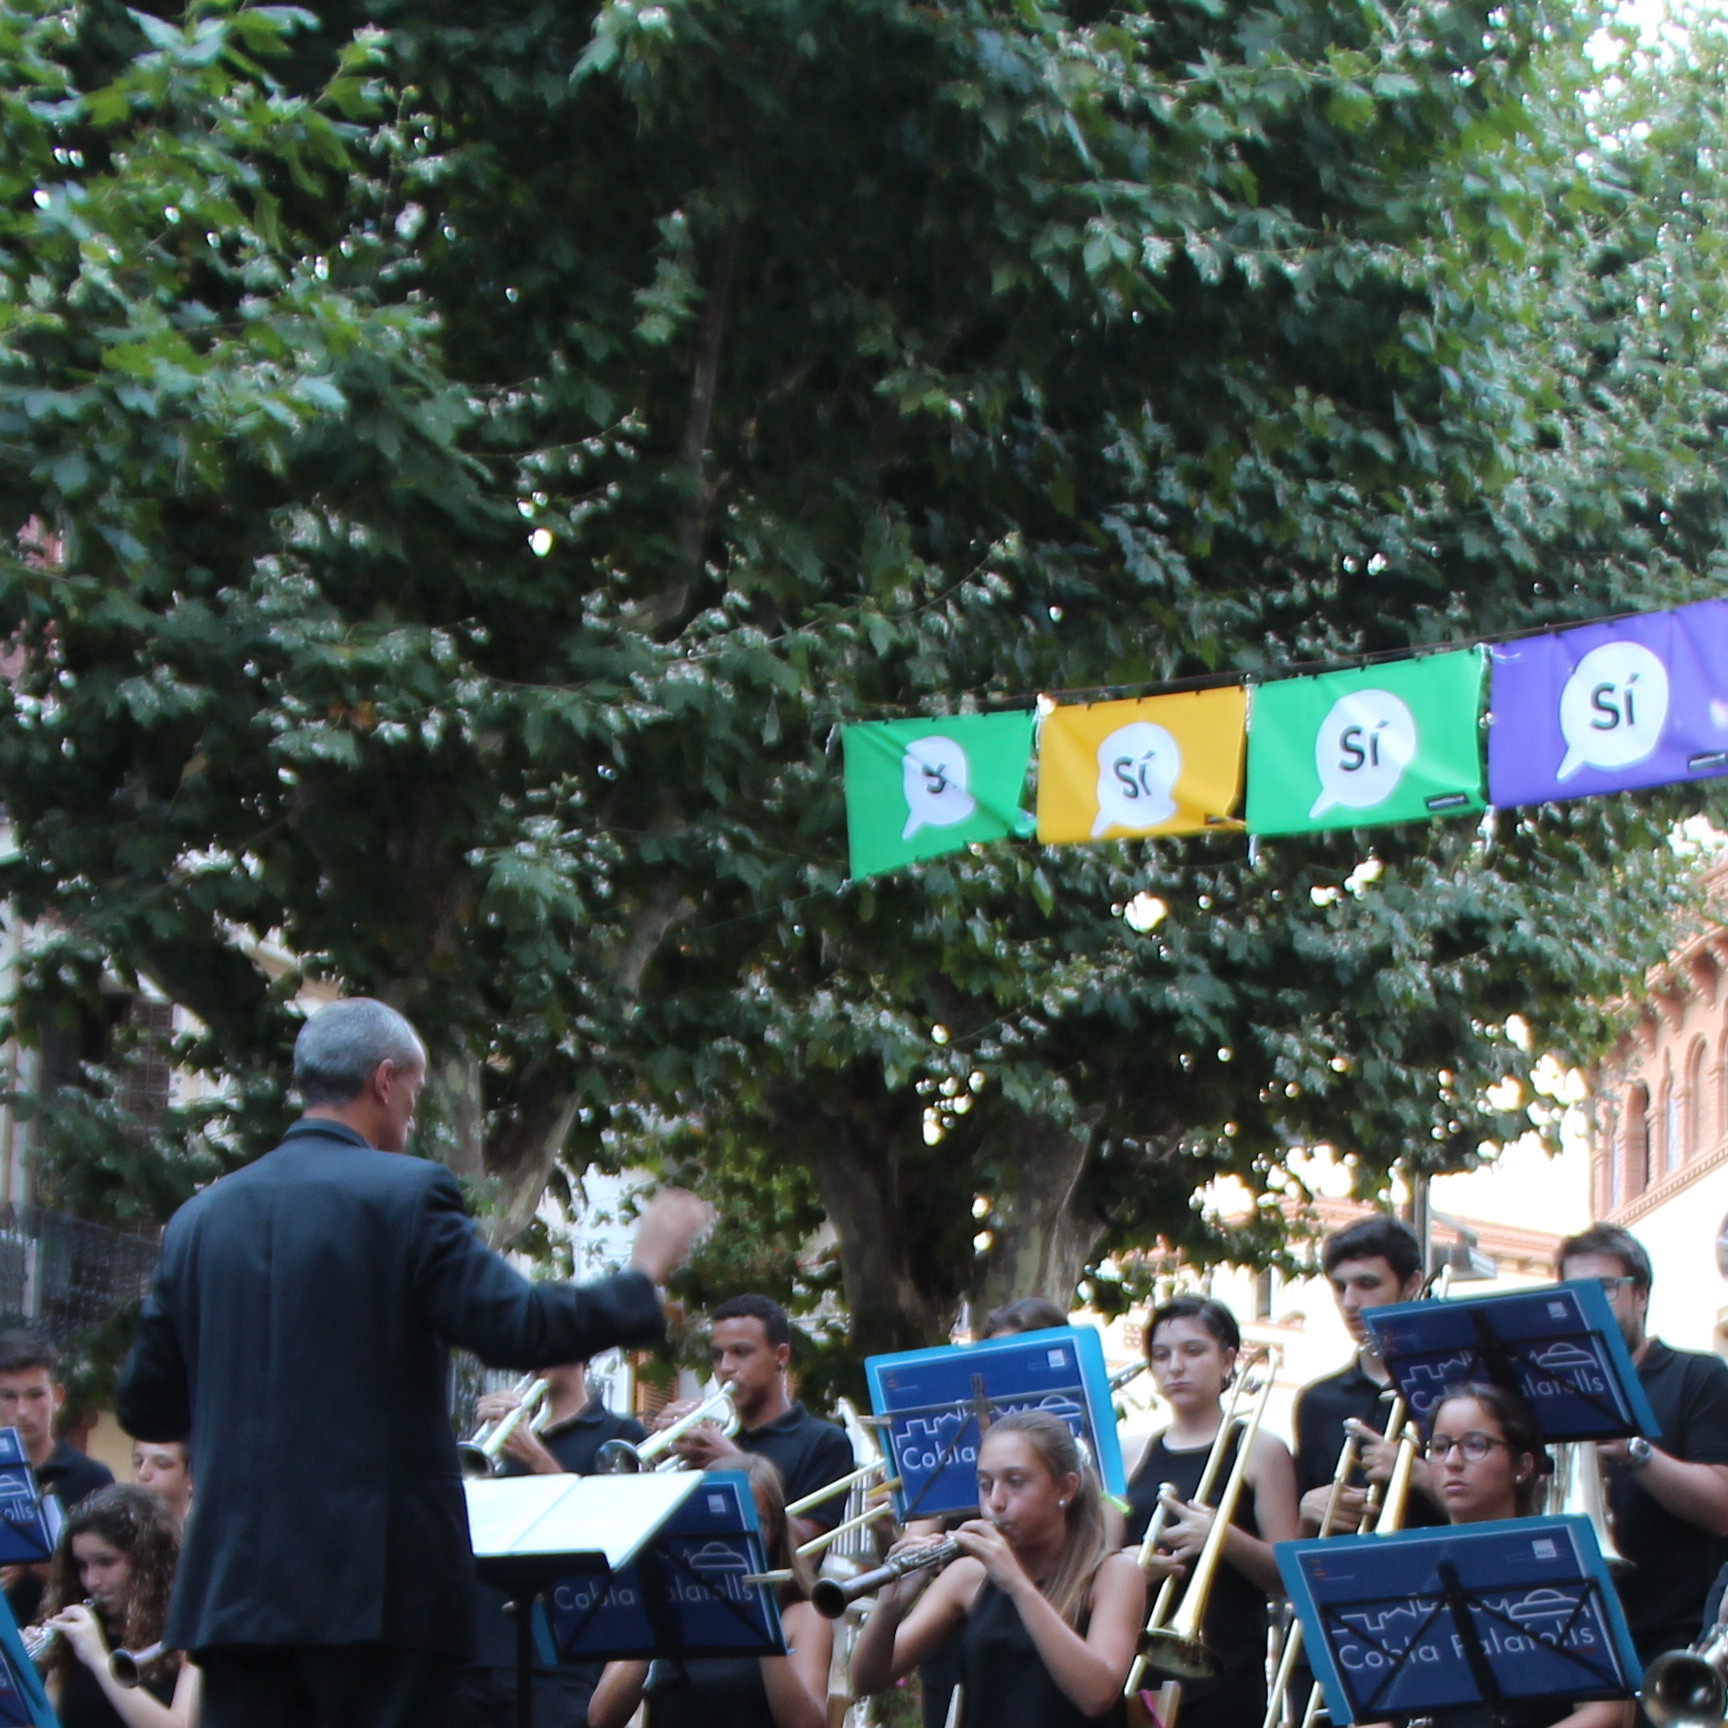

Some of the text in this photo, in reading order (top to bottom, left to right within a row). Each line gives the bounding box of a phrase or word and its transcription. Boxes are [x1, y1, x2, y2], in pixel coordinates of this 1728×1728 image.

[1589, 671, 1641, 731] Sí
[1338, 718, 1390, 772] Sí
[1112, 750, 1157, 800] Sí
[902, 1442, 976, 1470] Cobla
[1340, 1620, 1595, 1670] Cobla Plafolls
